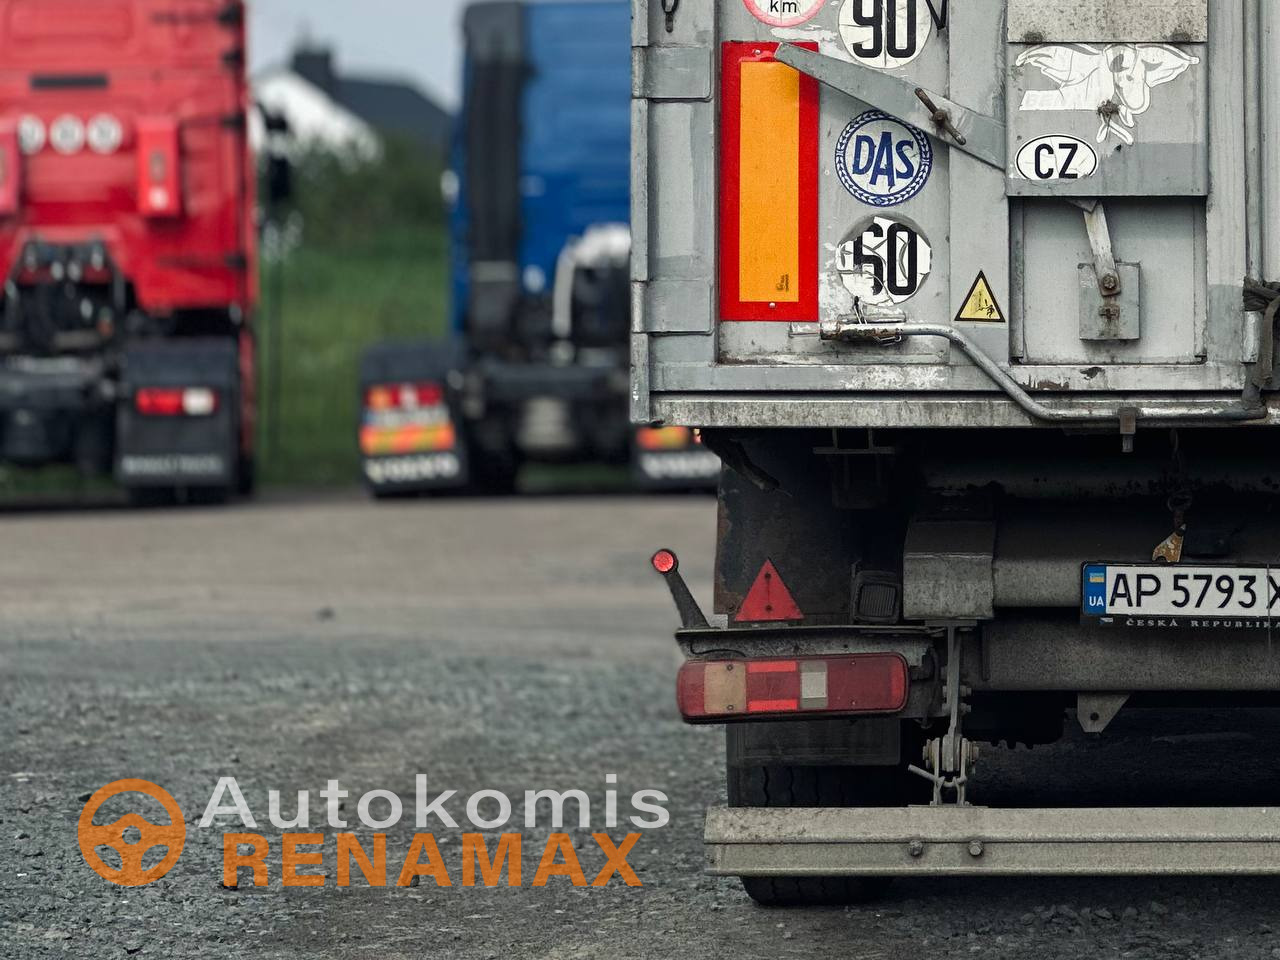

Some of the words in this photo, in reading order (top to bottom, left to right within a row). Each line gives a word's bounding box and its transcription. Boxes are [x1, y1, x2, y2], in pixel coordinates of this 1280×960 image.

[852, 131, 915, 187] DAS
[1034, 143, 1079, 180] CZ
[1089, 596, 1105, 607] UA
[1109, 573, 1162, 608] AP
[1171, 574, 1258, 610] 5793
